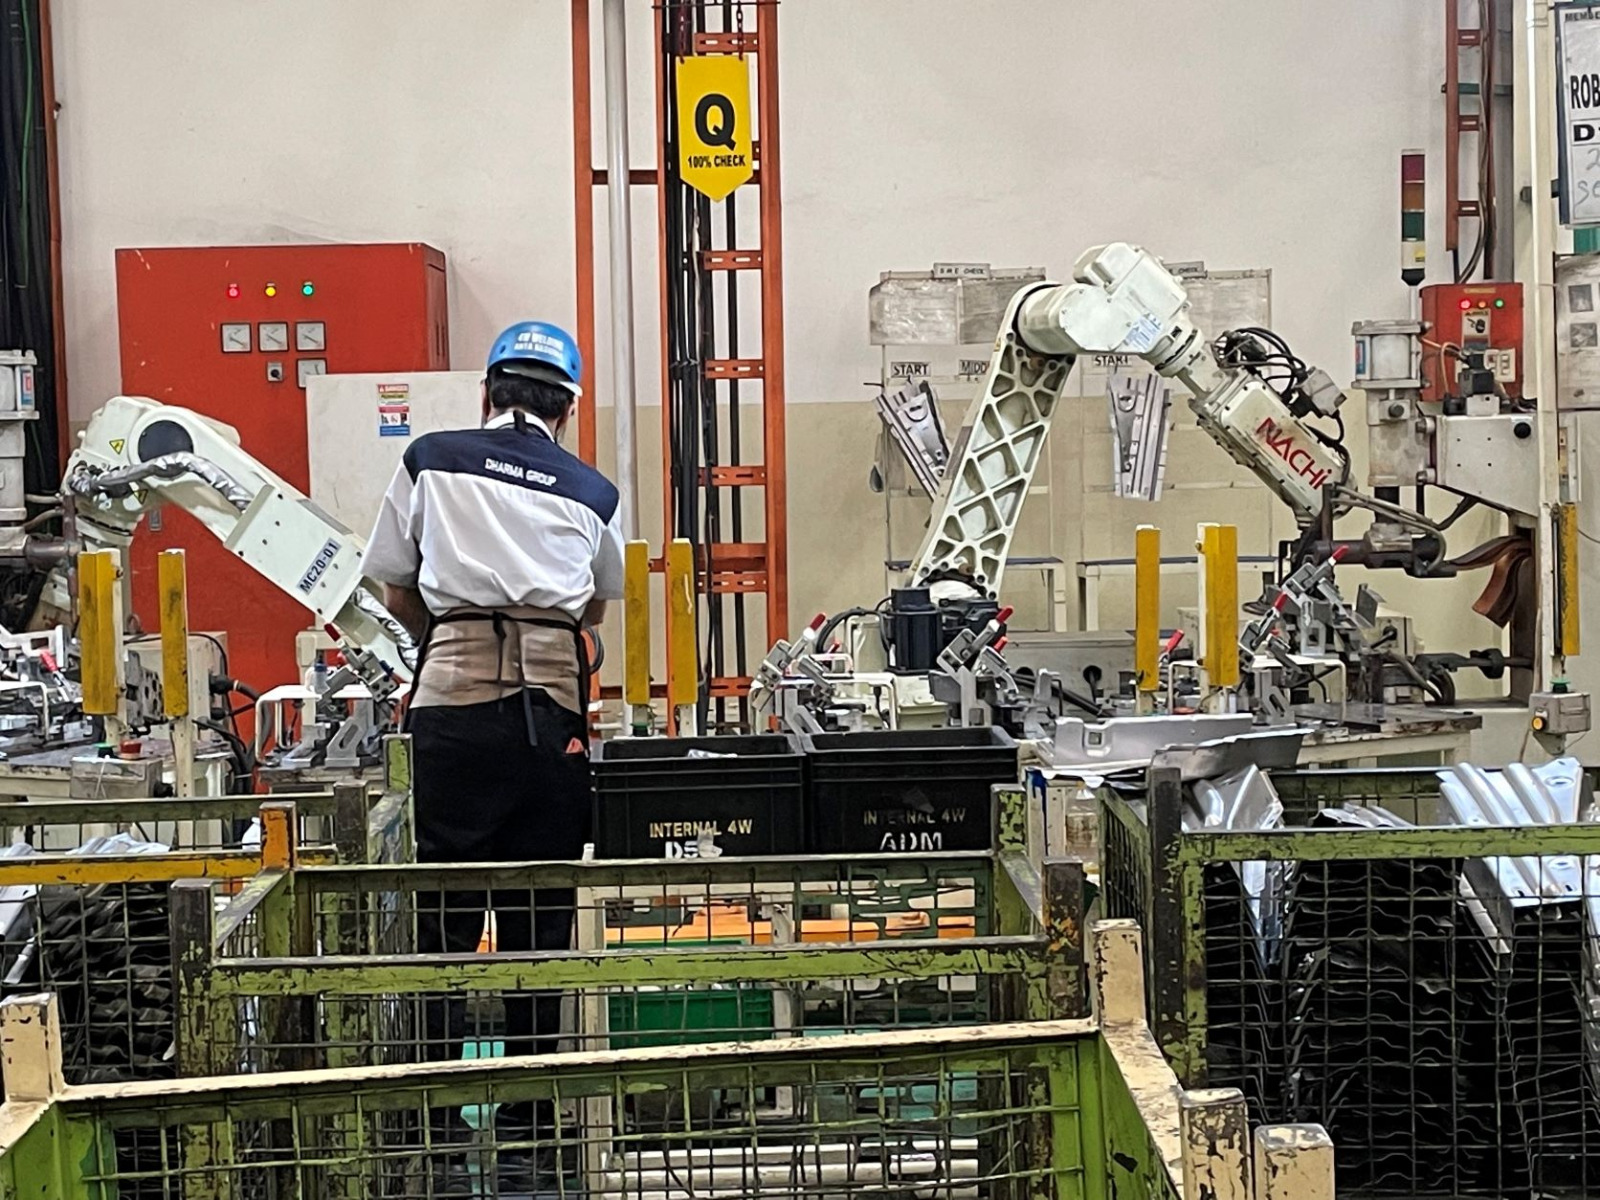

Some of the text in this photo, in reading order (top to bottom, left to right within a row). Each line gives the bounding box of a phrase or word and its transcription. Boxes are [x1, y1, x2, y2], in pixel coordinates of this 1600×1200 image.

[1570, 74, 1600, 109] ROB
[695, 93, 737, 151] Q
[1573, 123, 1600, 142] D
[688, 154, 746, 168] 100% CHECK
[893, 363, 929, 376] START
[484, 457, 557, 487] DHARMA GROUP
[300, 542, 338, 593] MC20-01
[863, 807, 966, 825] INNAL 4W
[649, 819, 753, 838] INTERNAL 4W
[880, 831, 943, 851] ADM
